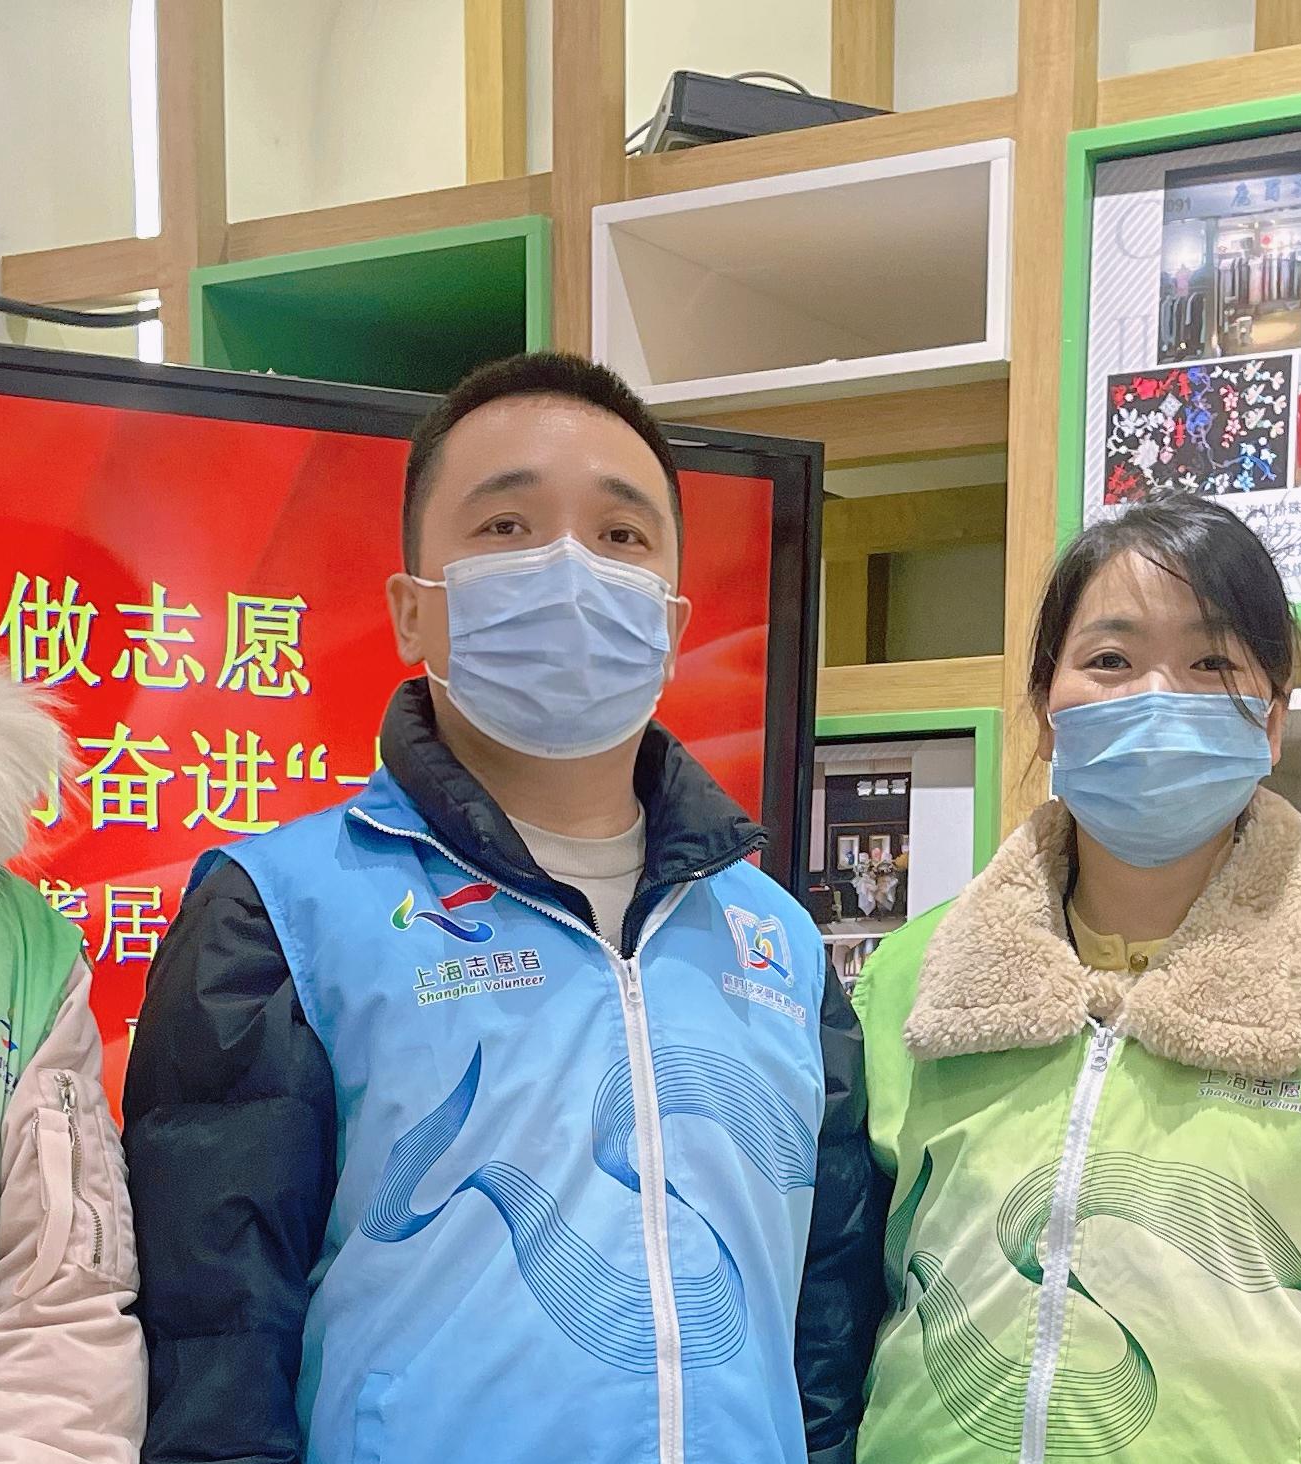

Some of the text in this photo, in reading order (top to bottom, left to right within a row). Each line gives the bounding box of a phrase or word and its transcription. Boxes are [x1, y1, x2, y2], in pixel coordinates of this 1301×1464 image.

[413, 950, 541, 990] 上海志愿者
[417, 975, 545, 1005] Shanghai Volunteer
